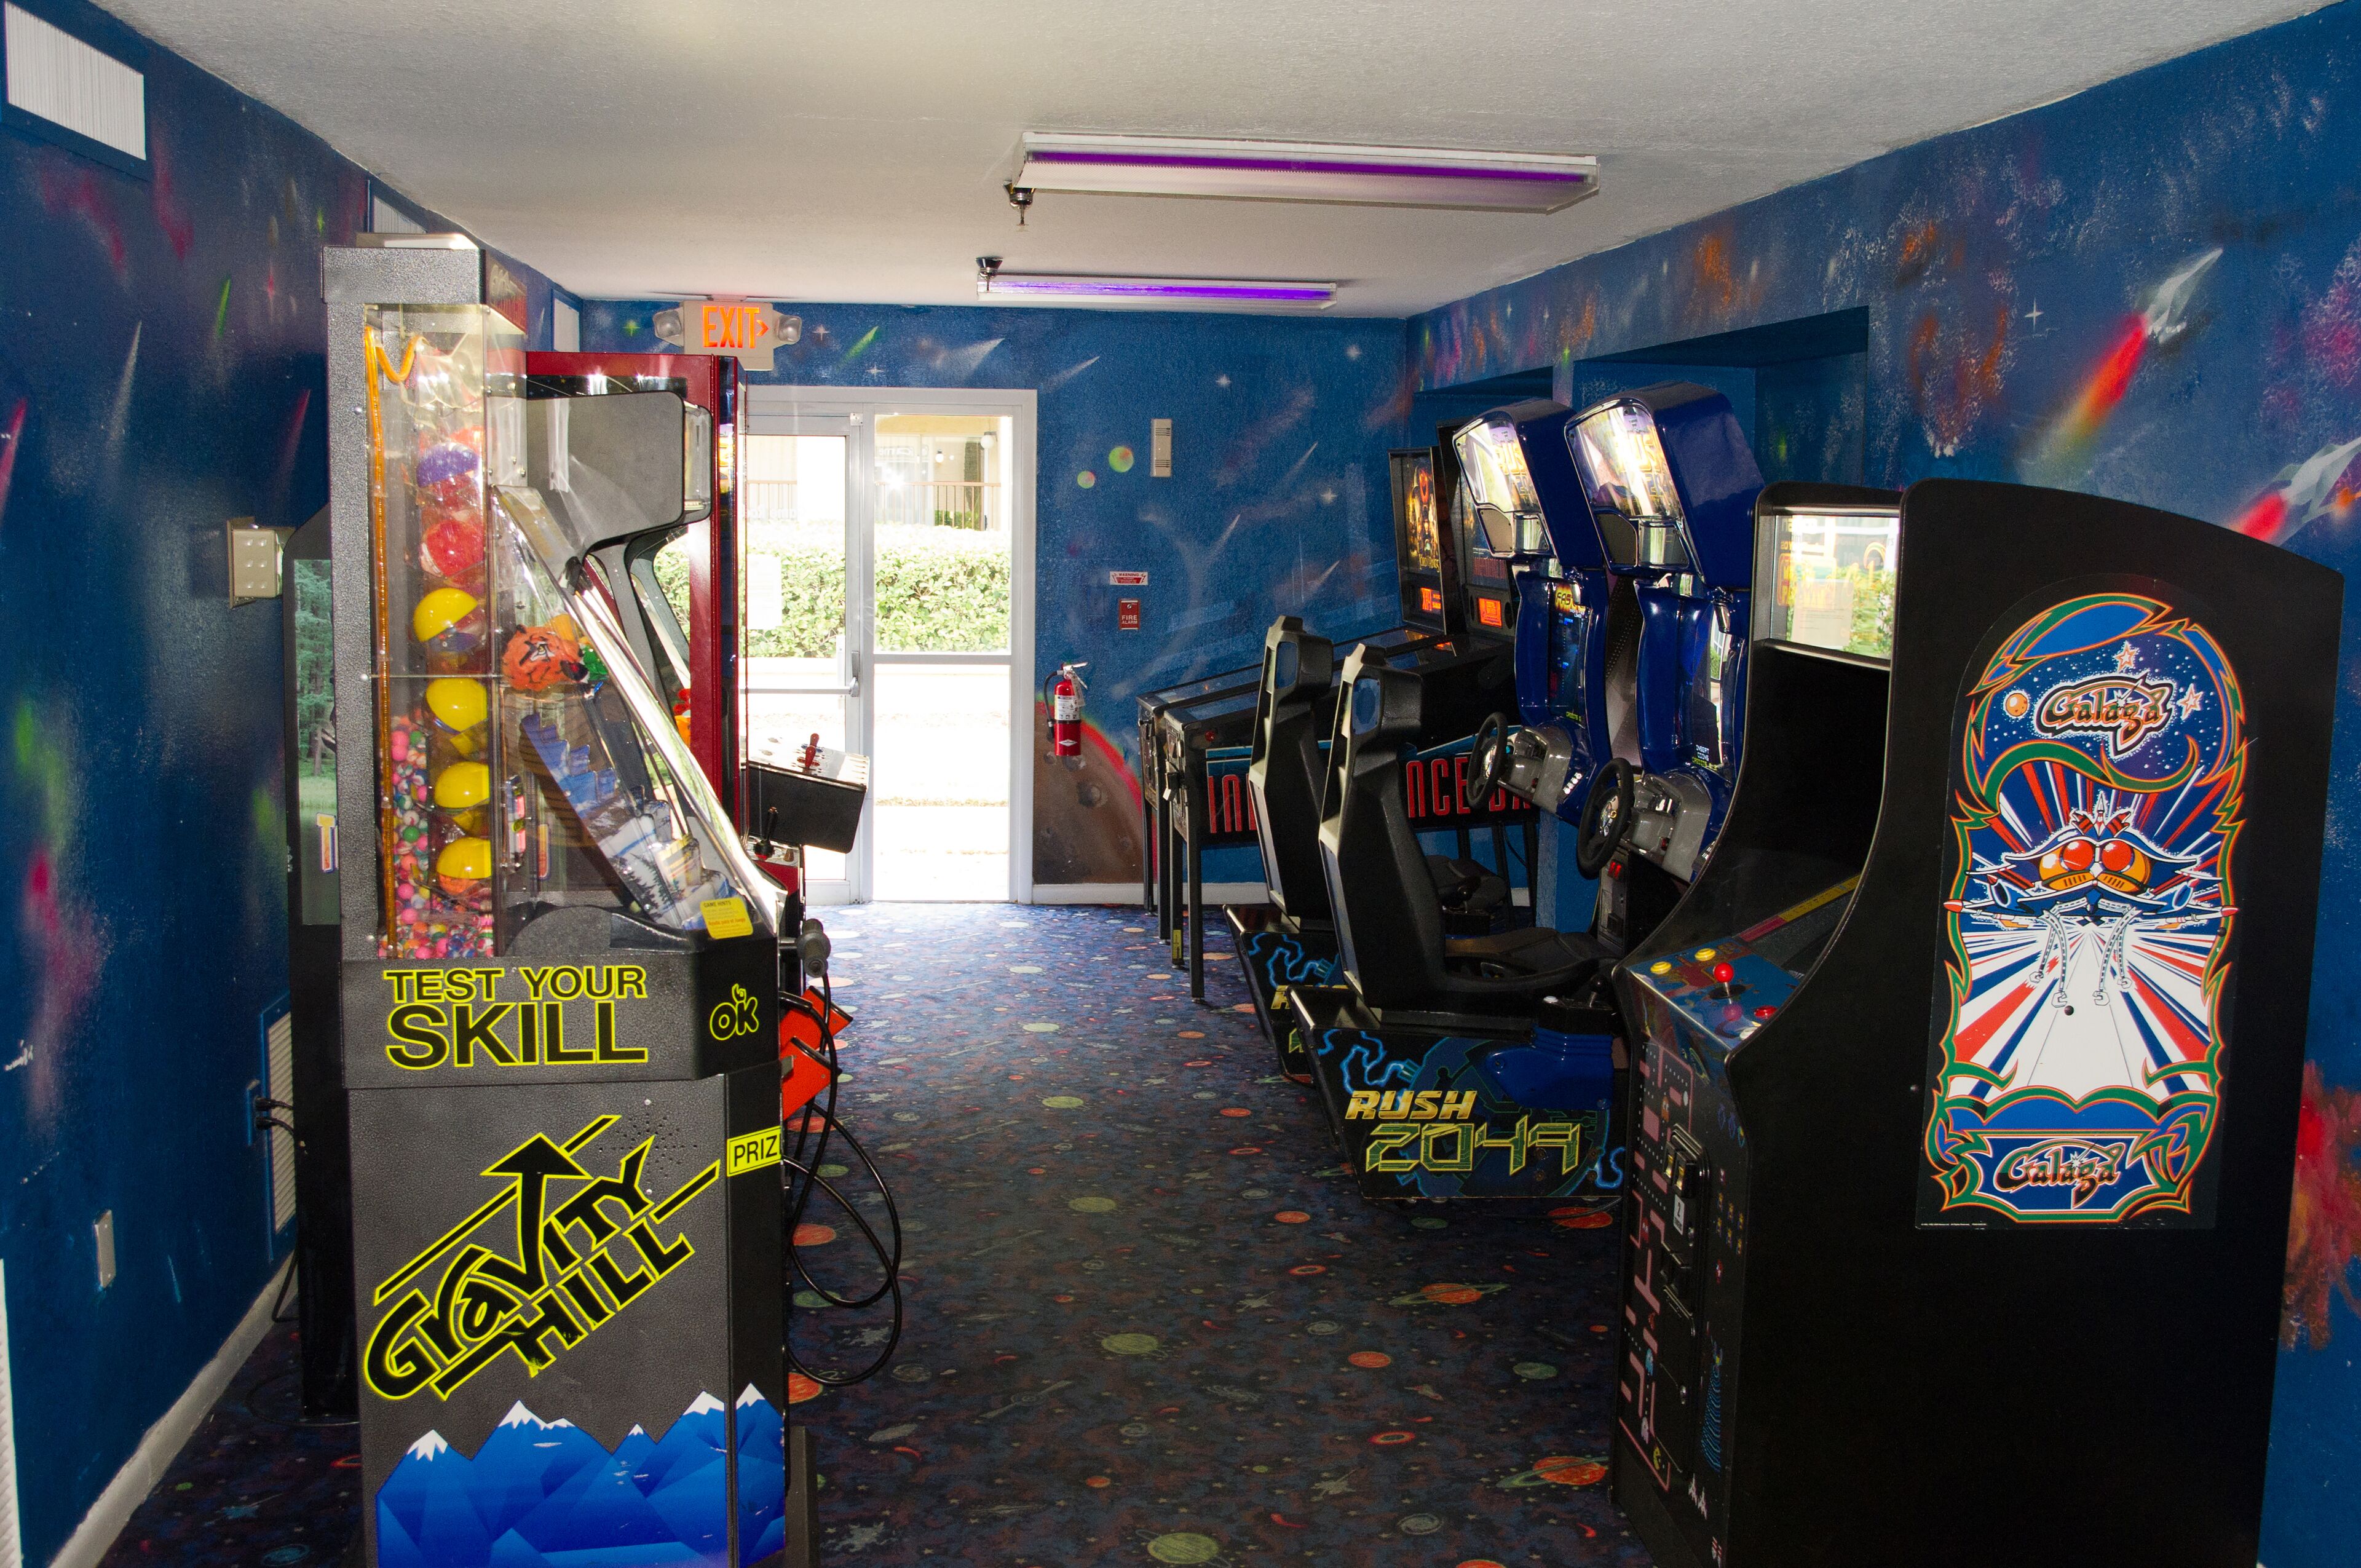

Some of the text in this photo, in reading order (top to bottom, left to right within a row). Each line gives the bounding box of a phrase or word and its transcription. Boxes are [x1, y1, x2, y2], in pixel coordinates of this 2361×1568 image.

[702, 305, 761, 349] EXIT
[1556, 592, 1574, 606] FAS
[2041, 679, 2169, 748] Galaga
[384, 965, 647, 1003] TEST YOUR
[709, 983, 759, 1041] OK
[386, 1001, 649, 1071] SKILL
[1345, 1090, 1477, 1120] RUSH
[734, 1134, 781, 1167] PRIZ
[1366, 1115, 1581, 1176] 2049
[1993, 1138, 2126, 1210] Galaga
[498, 1216, 695, 1378] HILL
